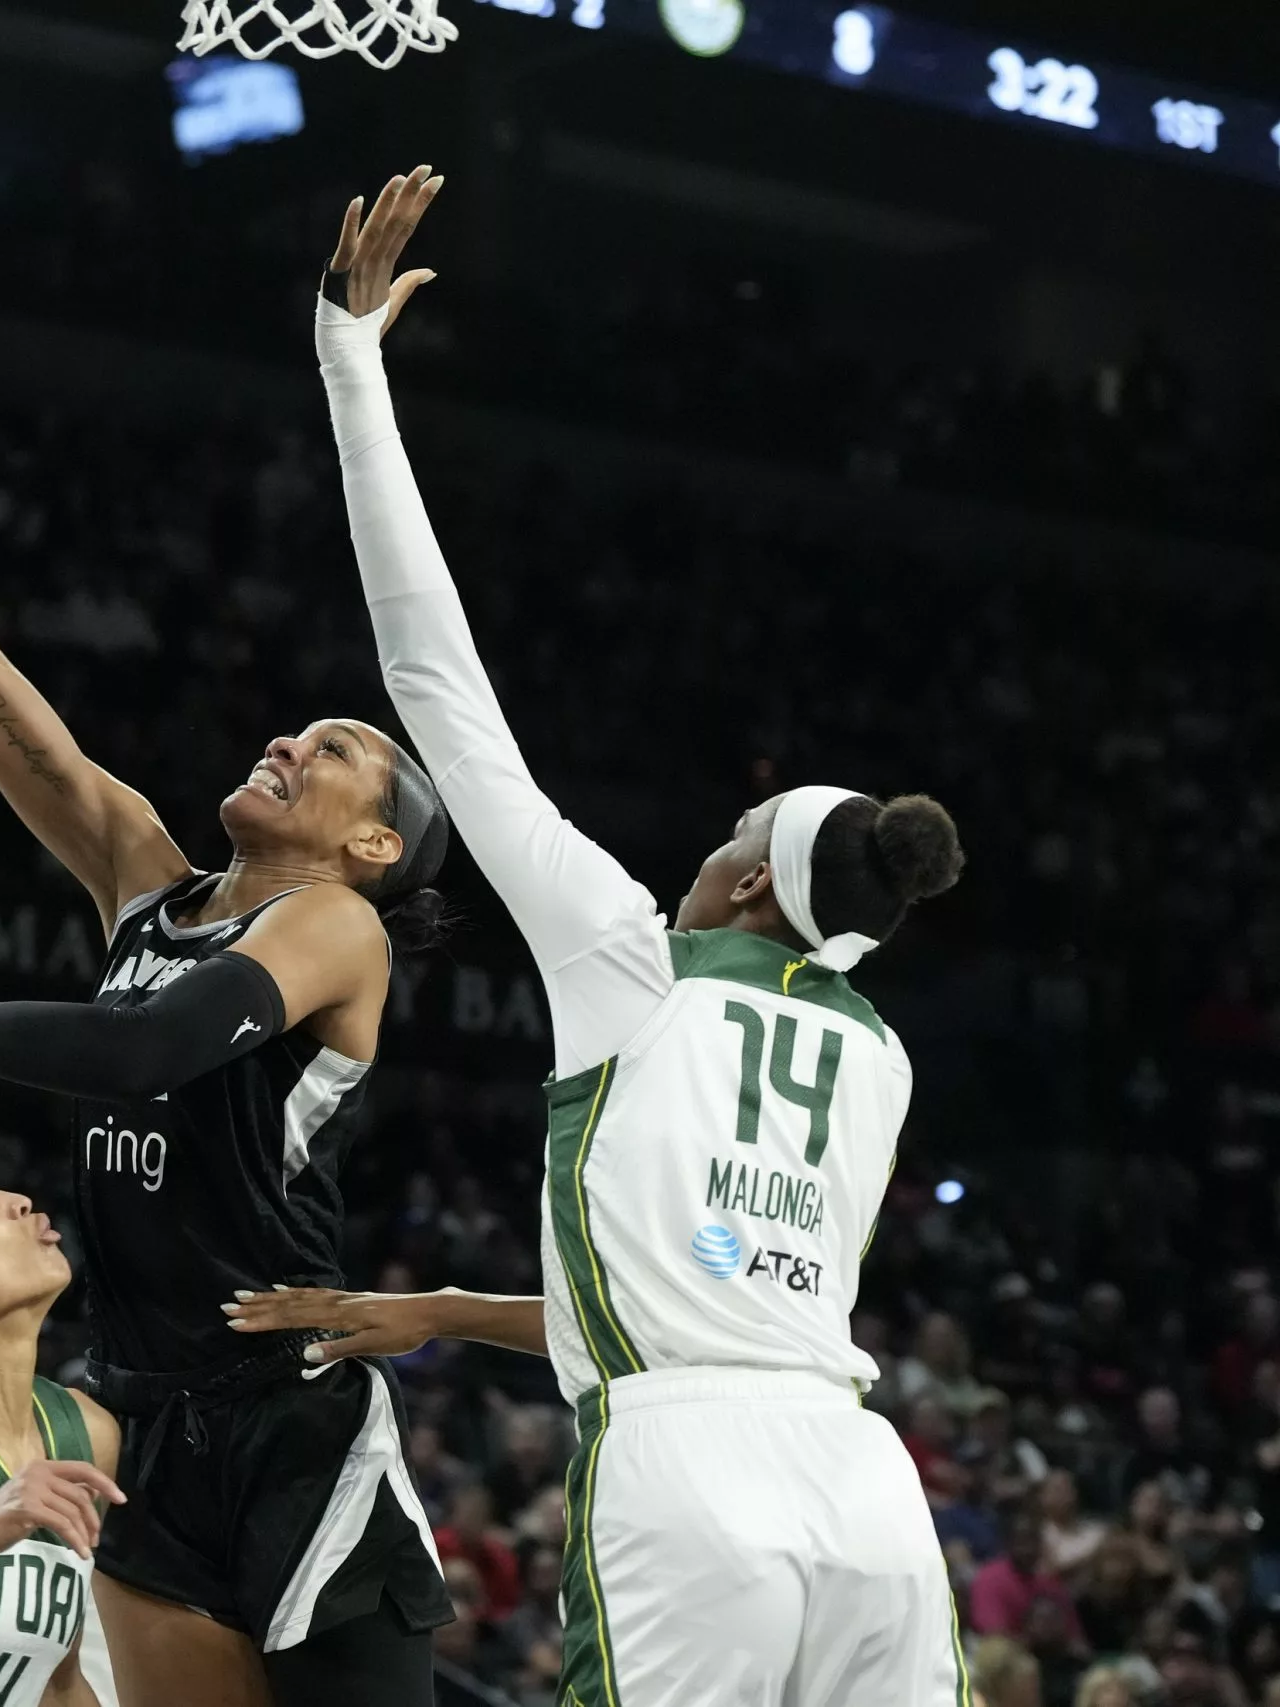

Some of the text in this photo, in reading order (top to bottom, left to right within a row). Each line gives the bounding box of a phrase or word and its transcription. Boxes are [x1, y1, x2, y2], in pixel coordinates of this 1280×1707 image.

[987, 47, 1099, 129] 3:22
[453, 963, 548, 1042] BA
[724, 999, 844, 1168] 14
[86, 1115, 167, 1192] ring
[706, 1157, 824, 1237] MALONGA
[746, 1246, 824, 1297] AT&T
